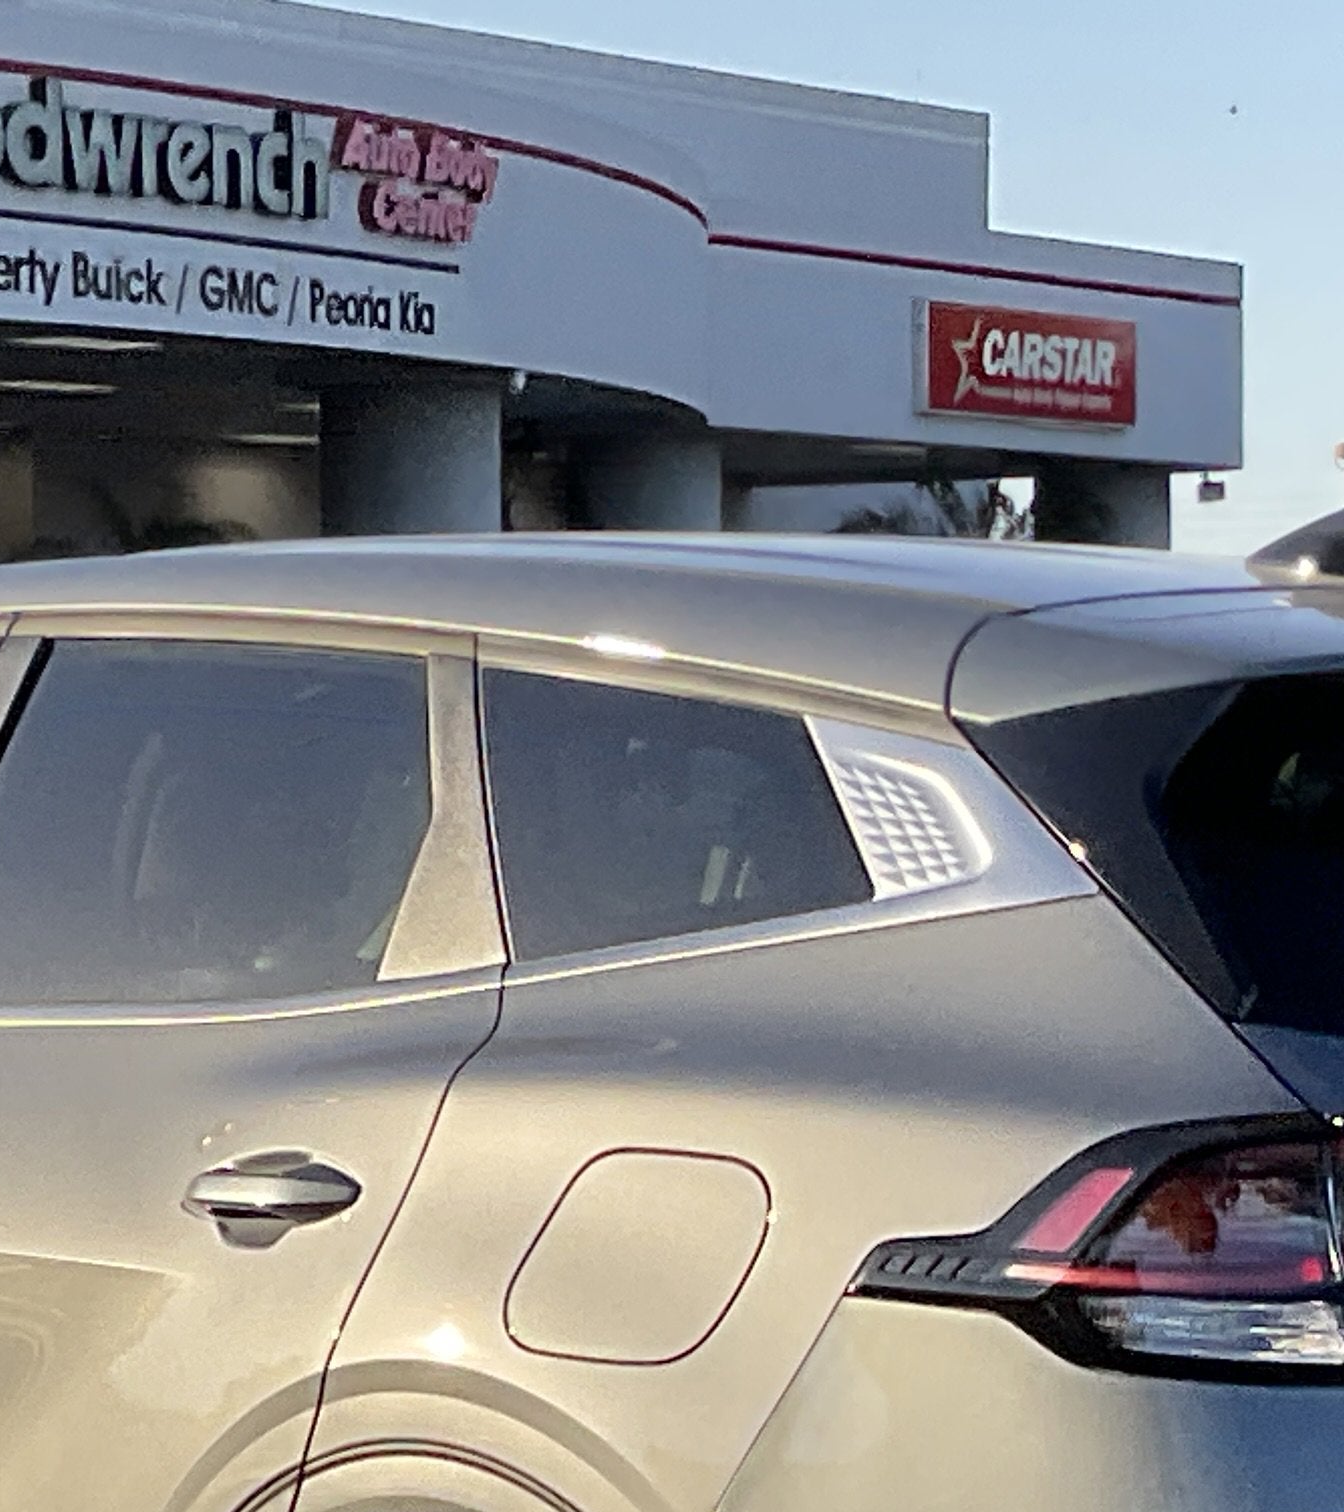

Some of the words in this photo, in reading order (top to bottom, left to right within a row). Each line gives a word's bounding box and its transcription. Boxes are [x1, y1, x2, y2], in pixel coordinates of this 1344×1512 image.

[339, 118, 420, 180] Auto
[370, 178, 475, 243] Center
[71, 250, 167, 306] Buick
[199, 264, 279, 317] GMC
[309, 277, 392, 332] Peoria
[398, 289, 436, 335] Kia
[982, 328, 1116, 386] CARSTAR
